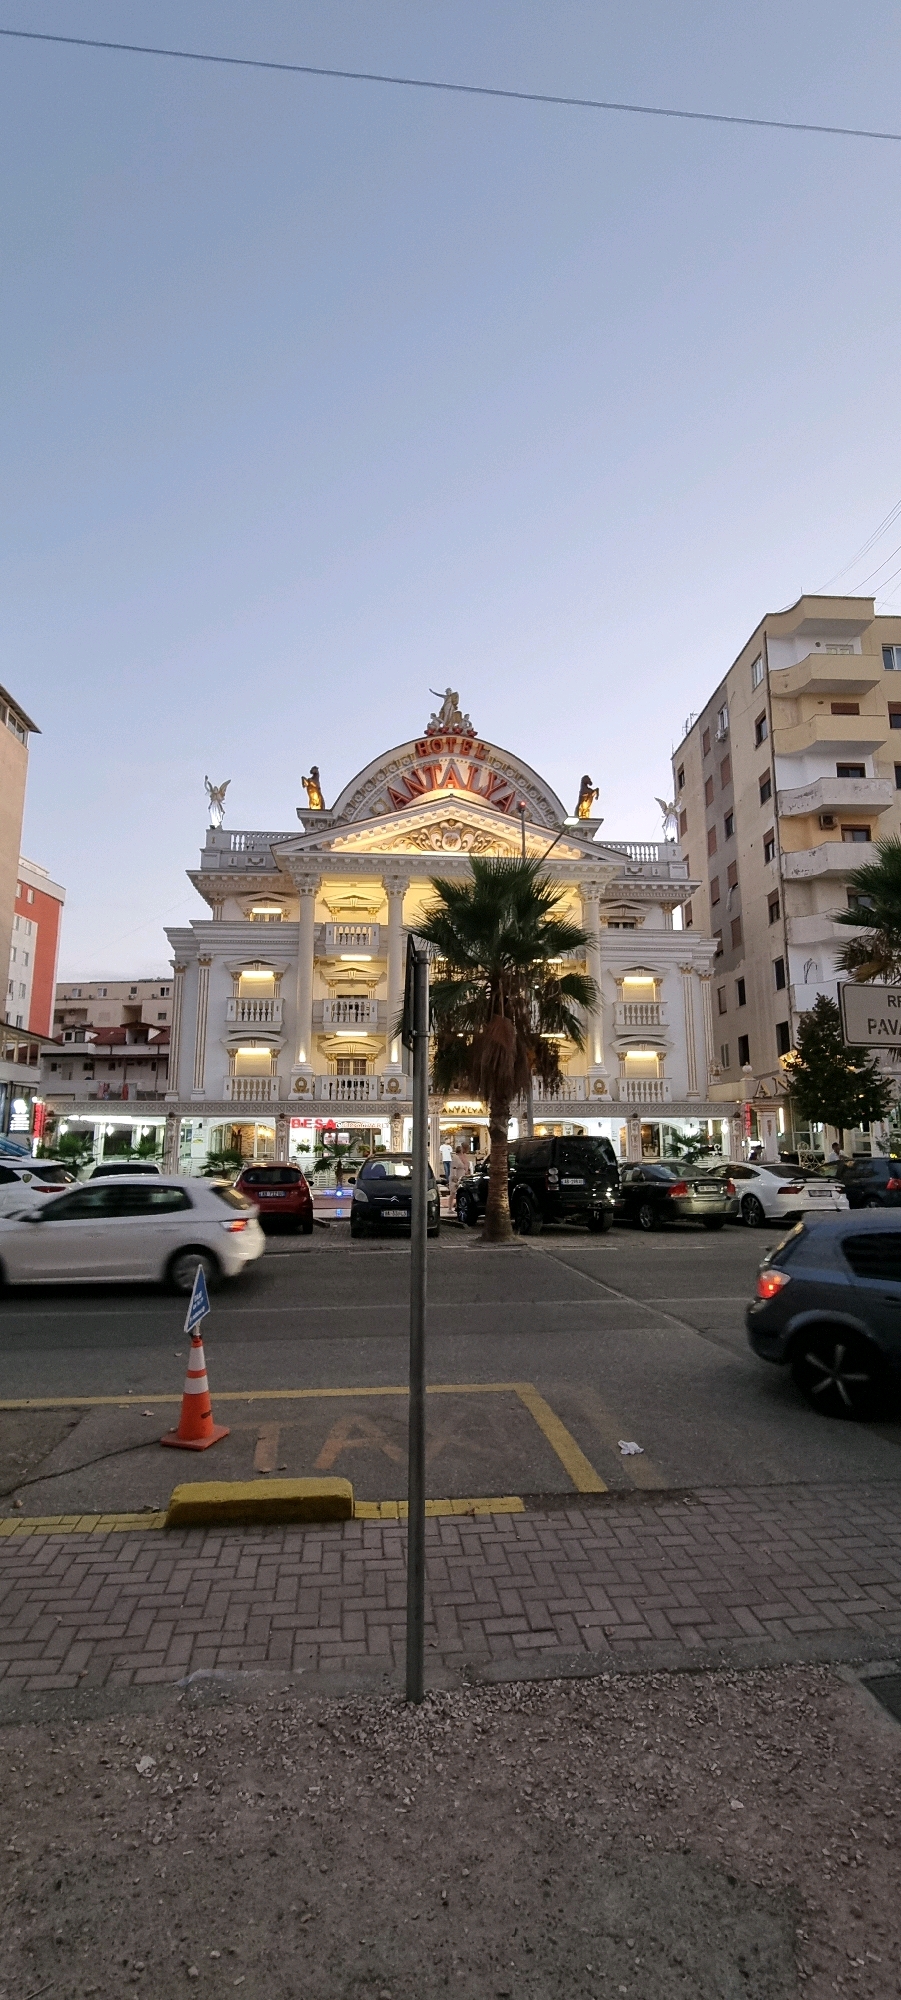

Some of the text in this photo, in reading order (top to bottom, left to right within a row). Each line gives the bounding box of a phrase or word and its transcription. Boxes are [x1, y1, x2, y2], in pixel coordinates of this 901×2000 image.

[415, 737, 489, 760] HOTEL
[387, 763, 516, 813] ANTALYA
[867, 1018, 901, 1036] PAV
[291, 1118, 337, 1130] BESA
